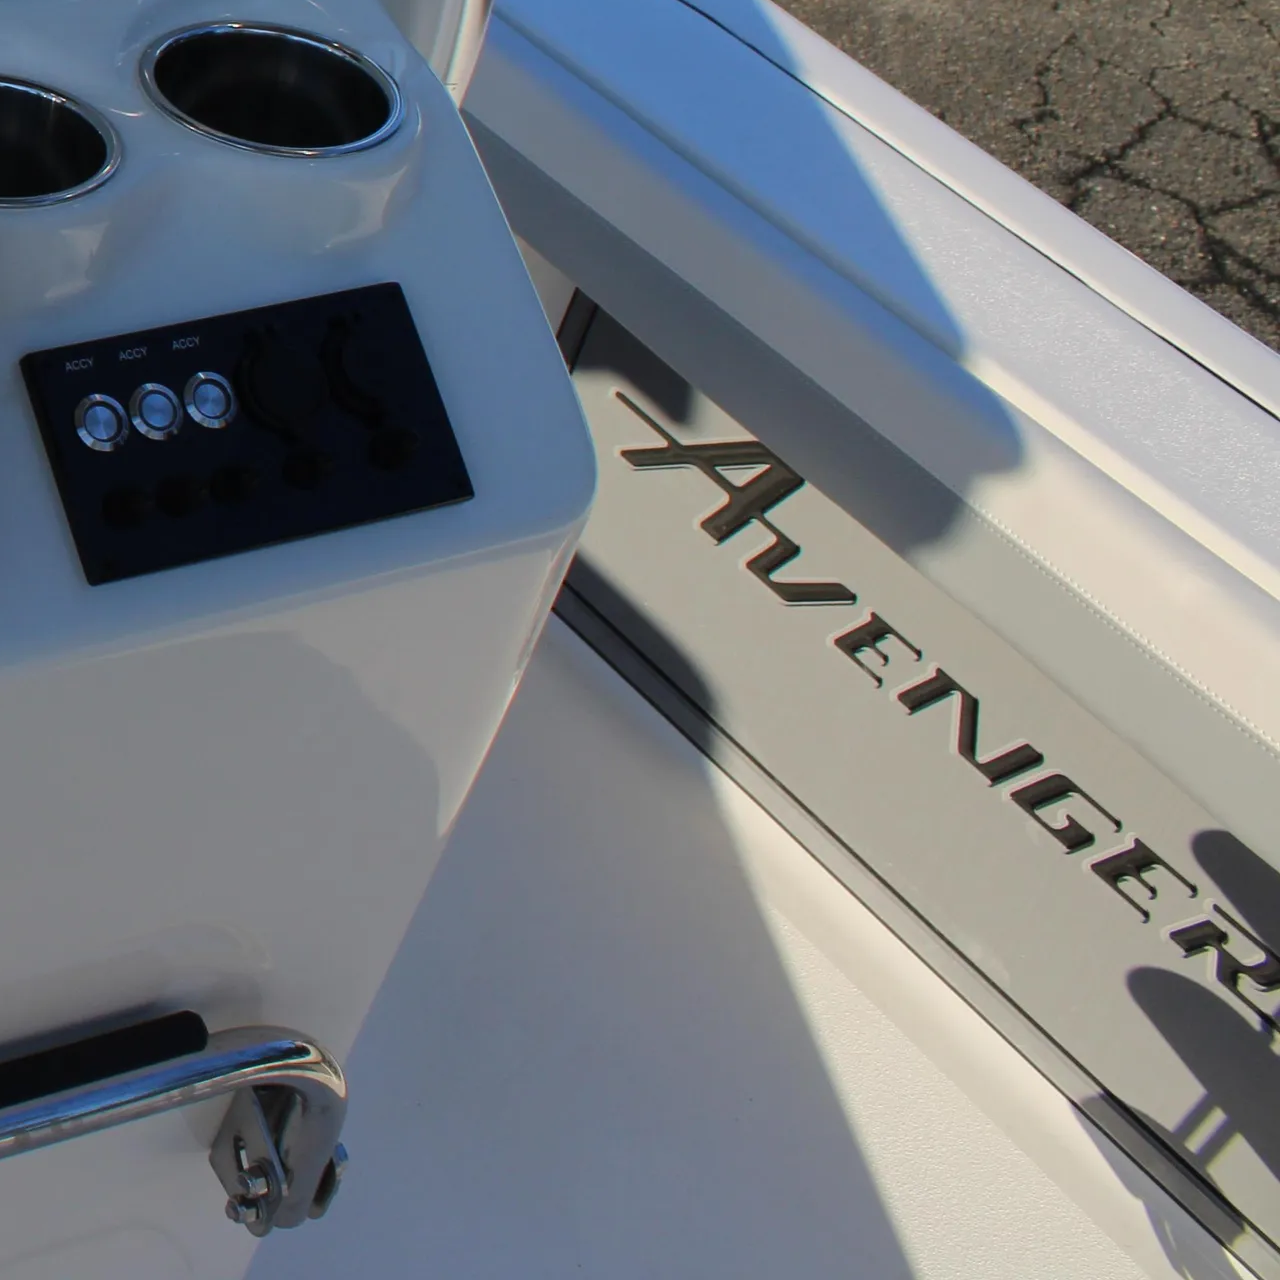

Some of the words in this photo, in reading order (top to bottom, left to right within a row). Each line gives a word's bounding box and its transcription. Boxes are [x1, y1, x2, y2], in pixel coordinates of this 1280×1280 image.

[172, 335, 200, 351] ACCY
[119, 346, 148, 362] ACCY
[65, 357, 94, 373] ACCY
